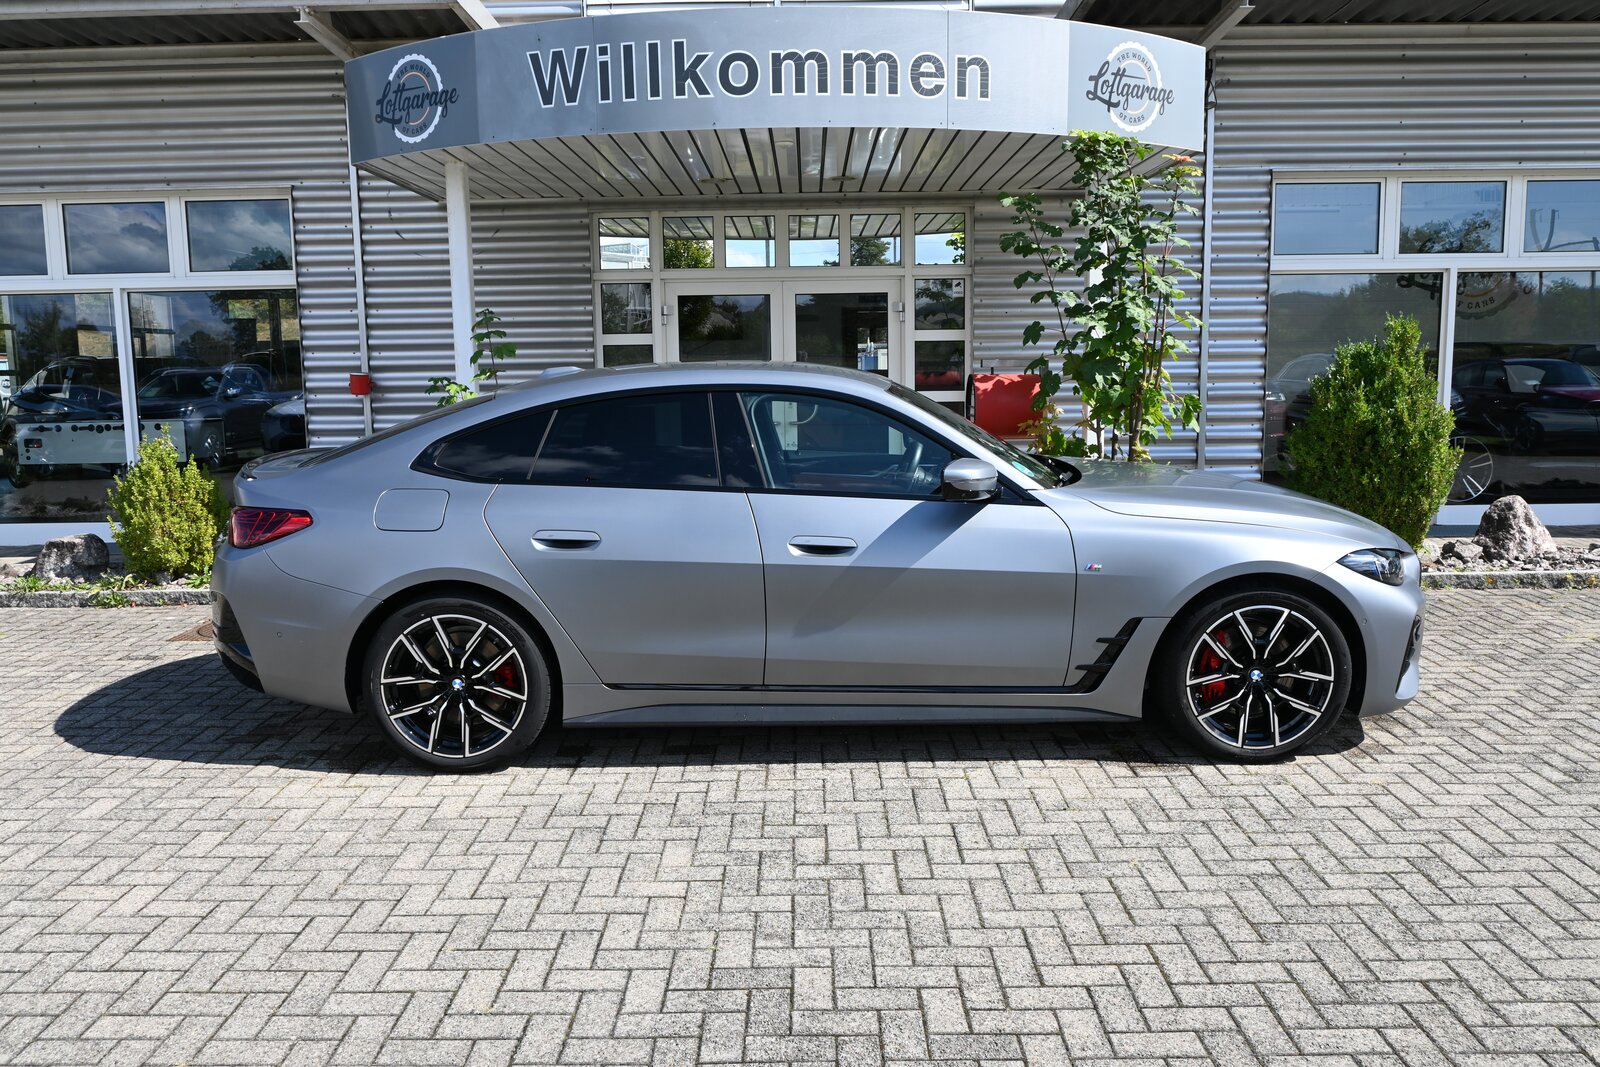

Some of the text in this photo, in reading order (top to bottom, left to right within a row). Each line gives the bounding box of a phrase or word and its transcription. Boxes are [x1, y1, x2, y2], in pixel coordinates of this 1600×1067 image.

[396, 64, 430, 79] THE WORLD
[1117, 52, 1152, 72] THE WORLD
[526, 38, 991, 108] Willkommen
[1086, 60, 1175, 116] Loftgarage
[375, 80, 459, 131] Loftgarage
[1119, 112, 1145, 123] OF CARS
[1467, 296, 1496, 310] CARS
